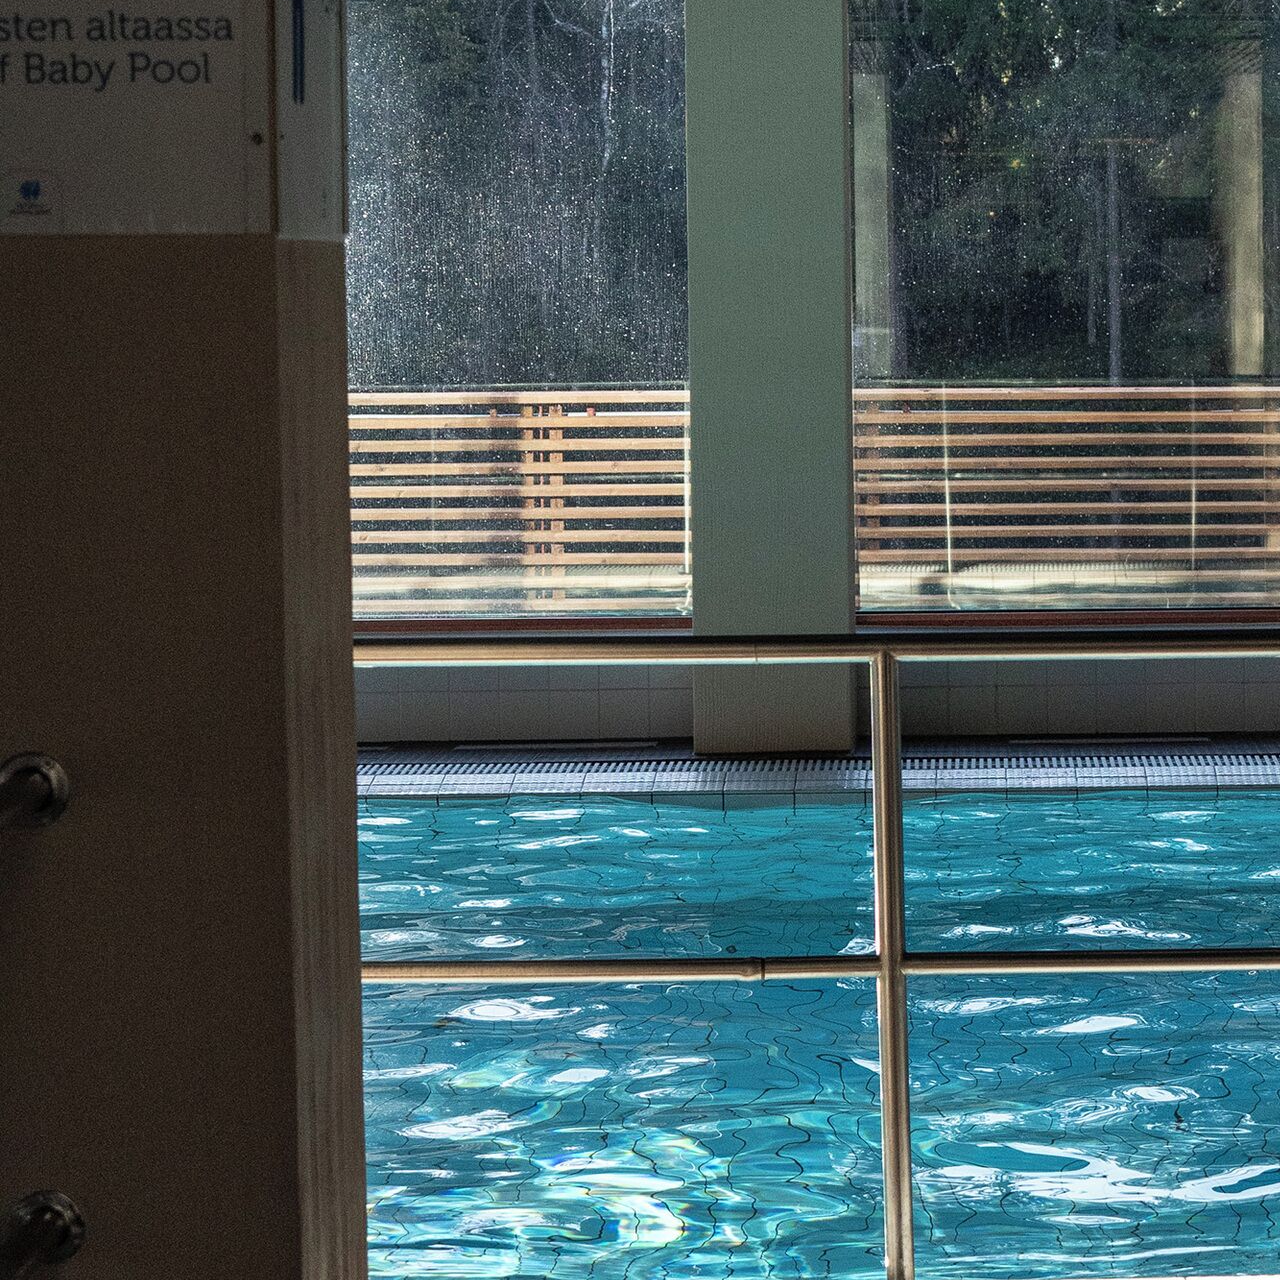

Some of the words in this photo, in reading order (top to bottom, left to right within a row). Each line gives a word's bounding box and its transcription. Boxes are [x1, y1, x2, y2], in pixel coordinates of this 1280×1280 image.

[86, 10, 234, 42] altaassa
[24, 52, 116, 92] Baby
[128, 52, 212, 84] Pool
